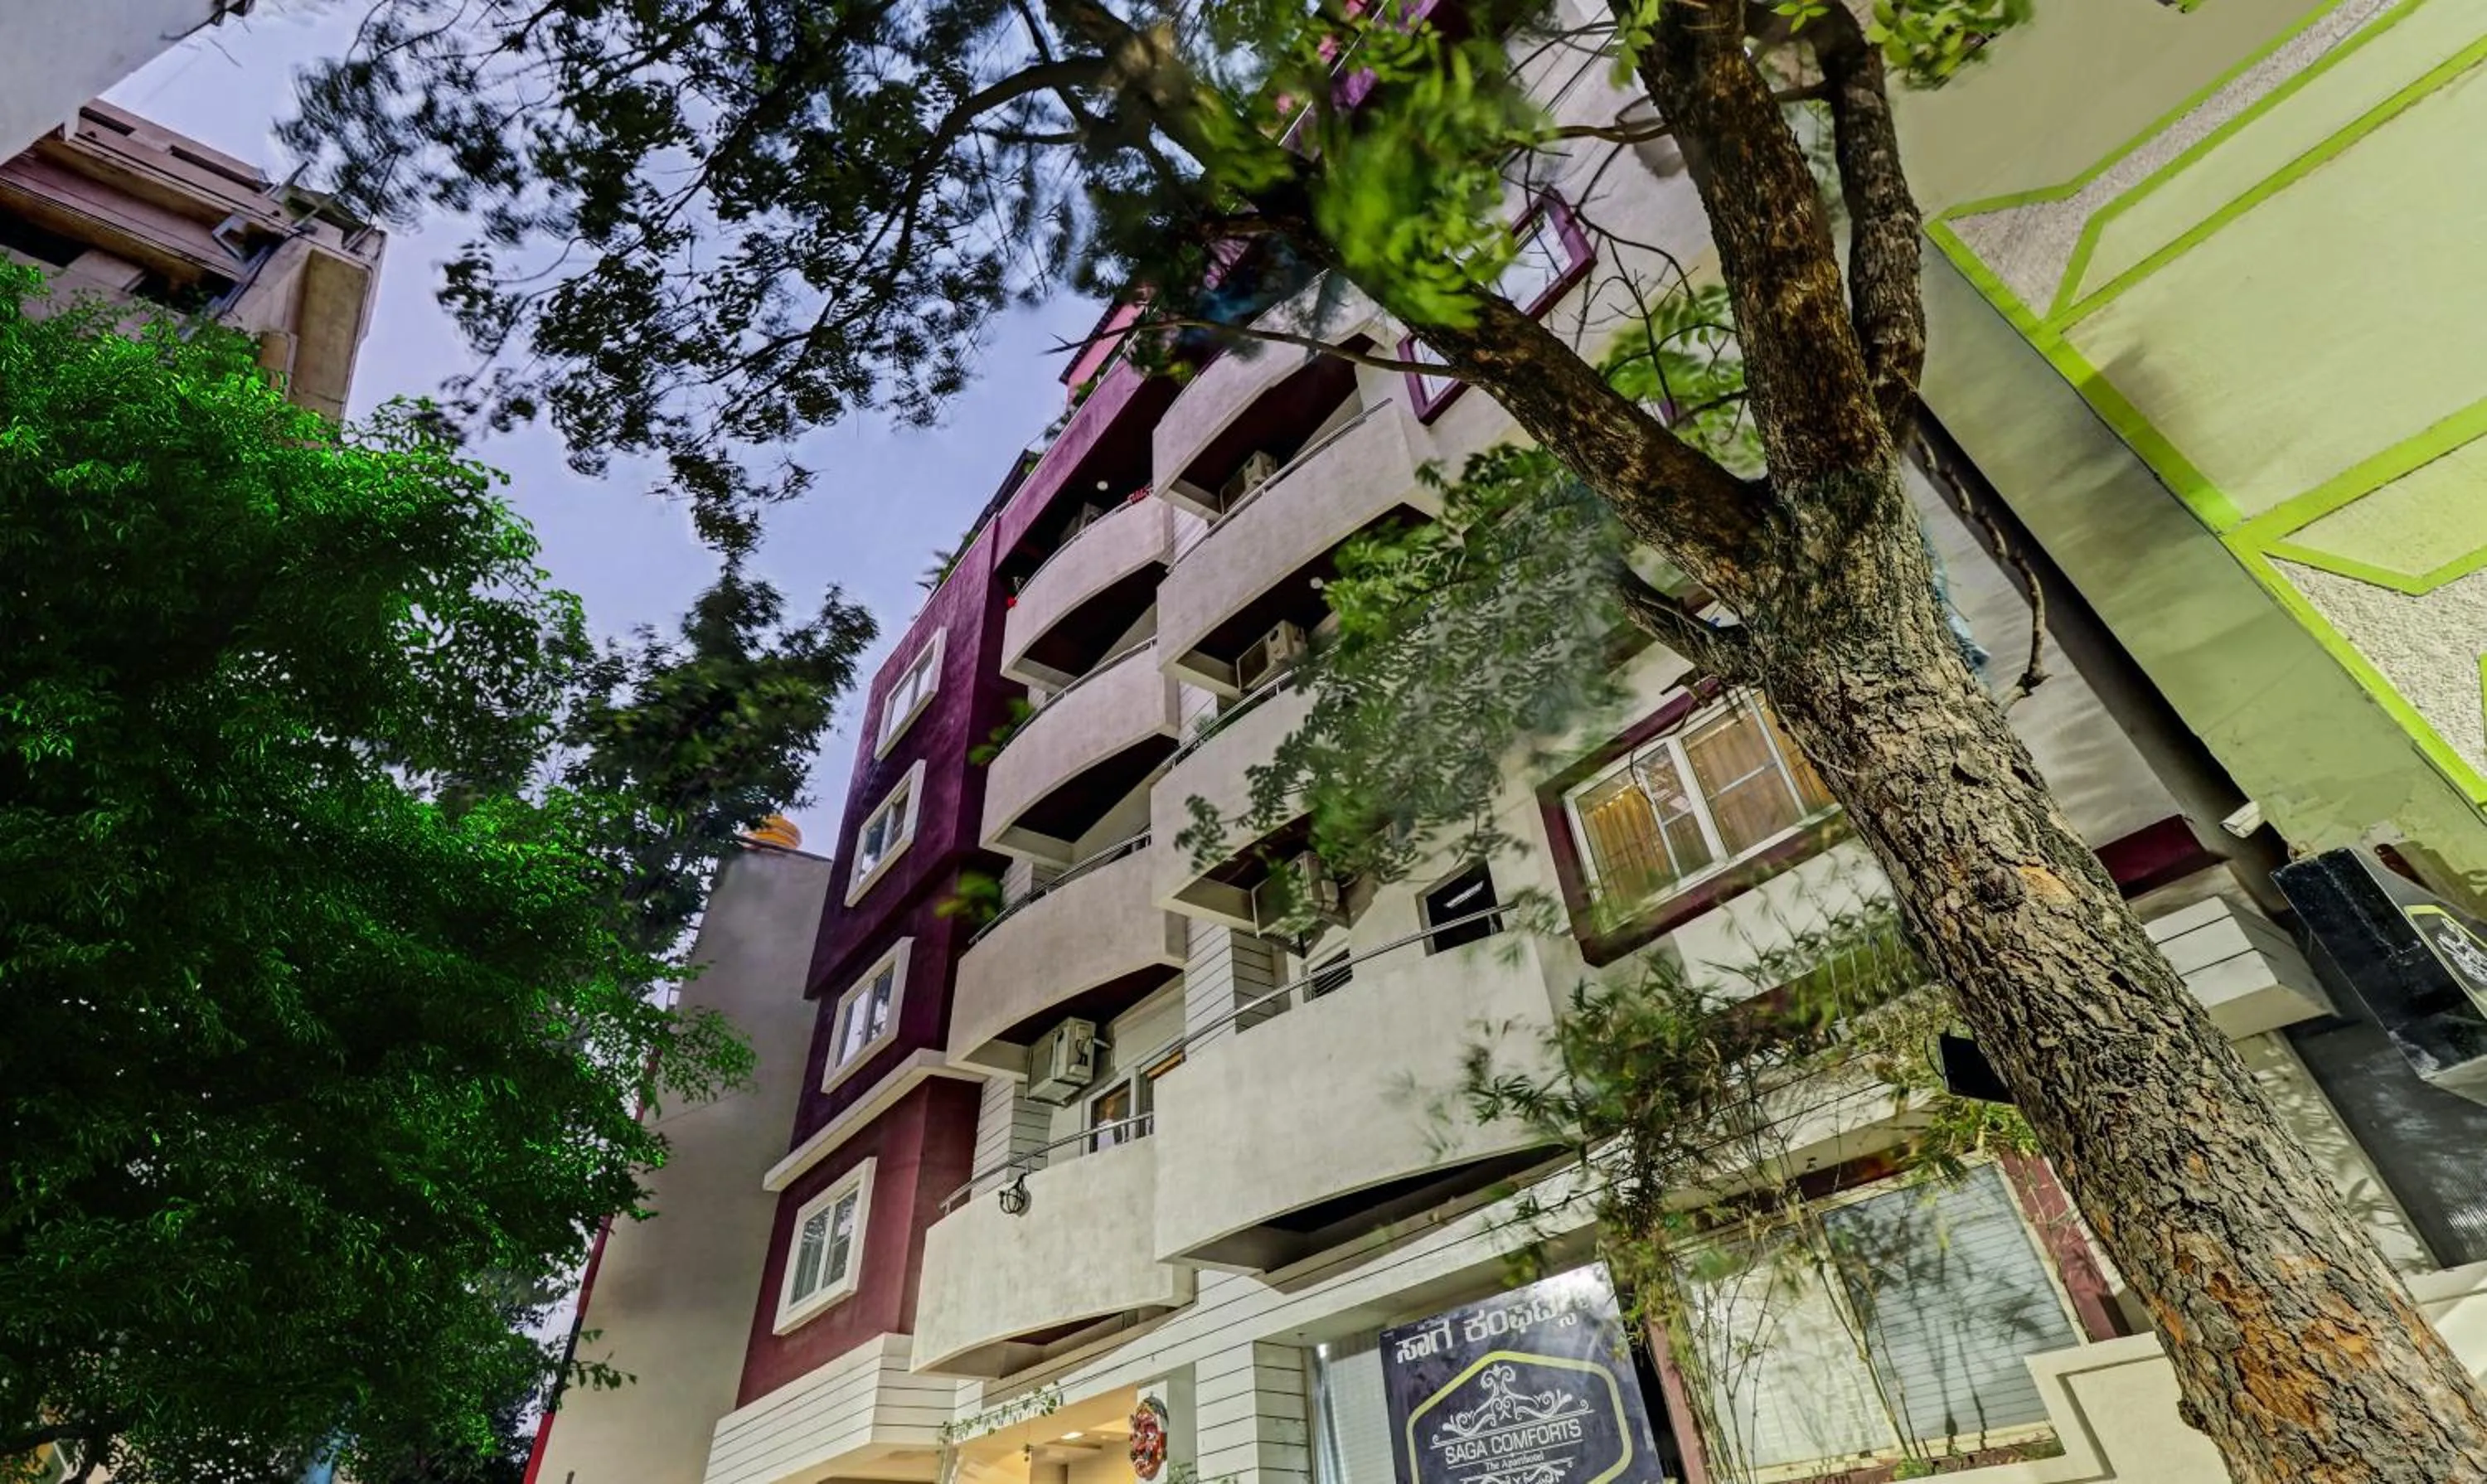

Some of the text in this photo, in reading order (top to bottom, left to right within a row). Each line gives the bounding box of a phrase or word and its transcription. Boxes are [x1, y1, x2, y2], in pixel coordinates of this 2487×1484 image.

[1445, 1419, 1582, 1465] SAGA COMFORTS
[1486, 1460, 1500, 1472] The
